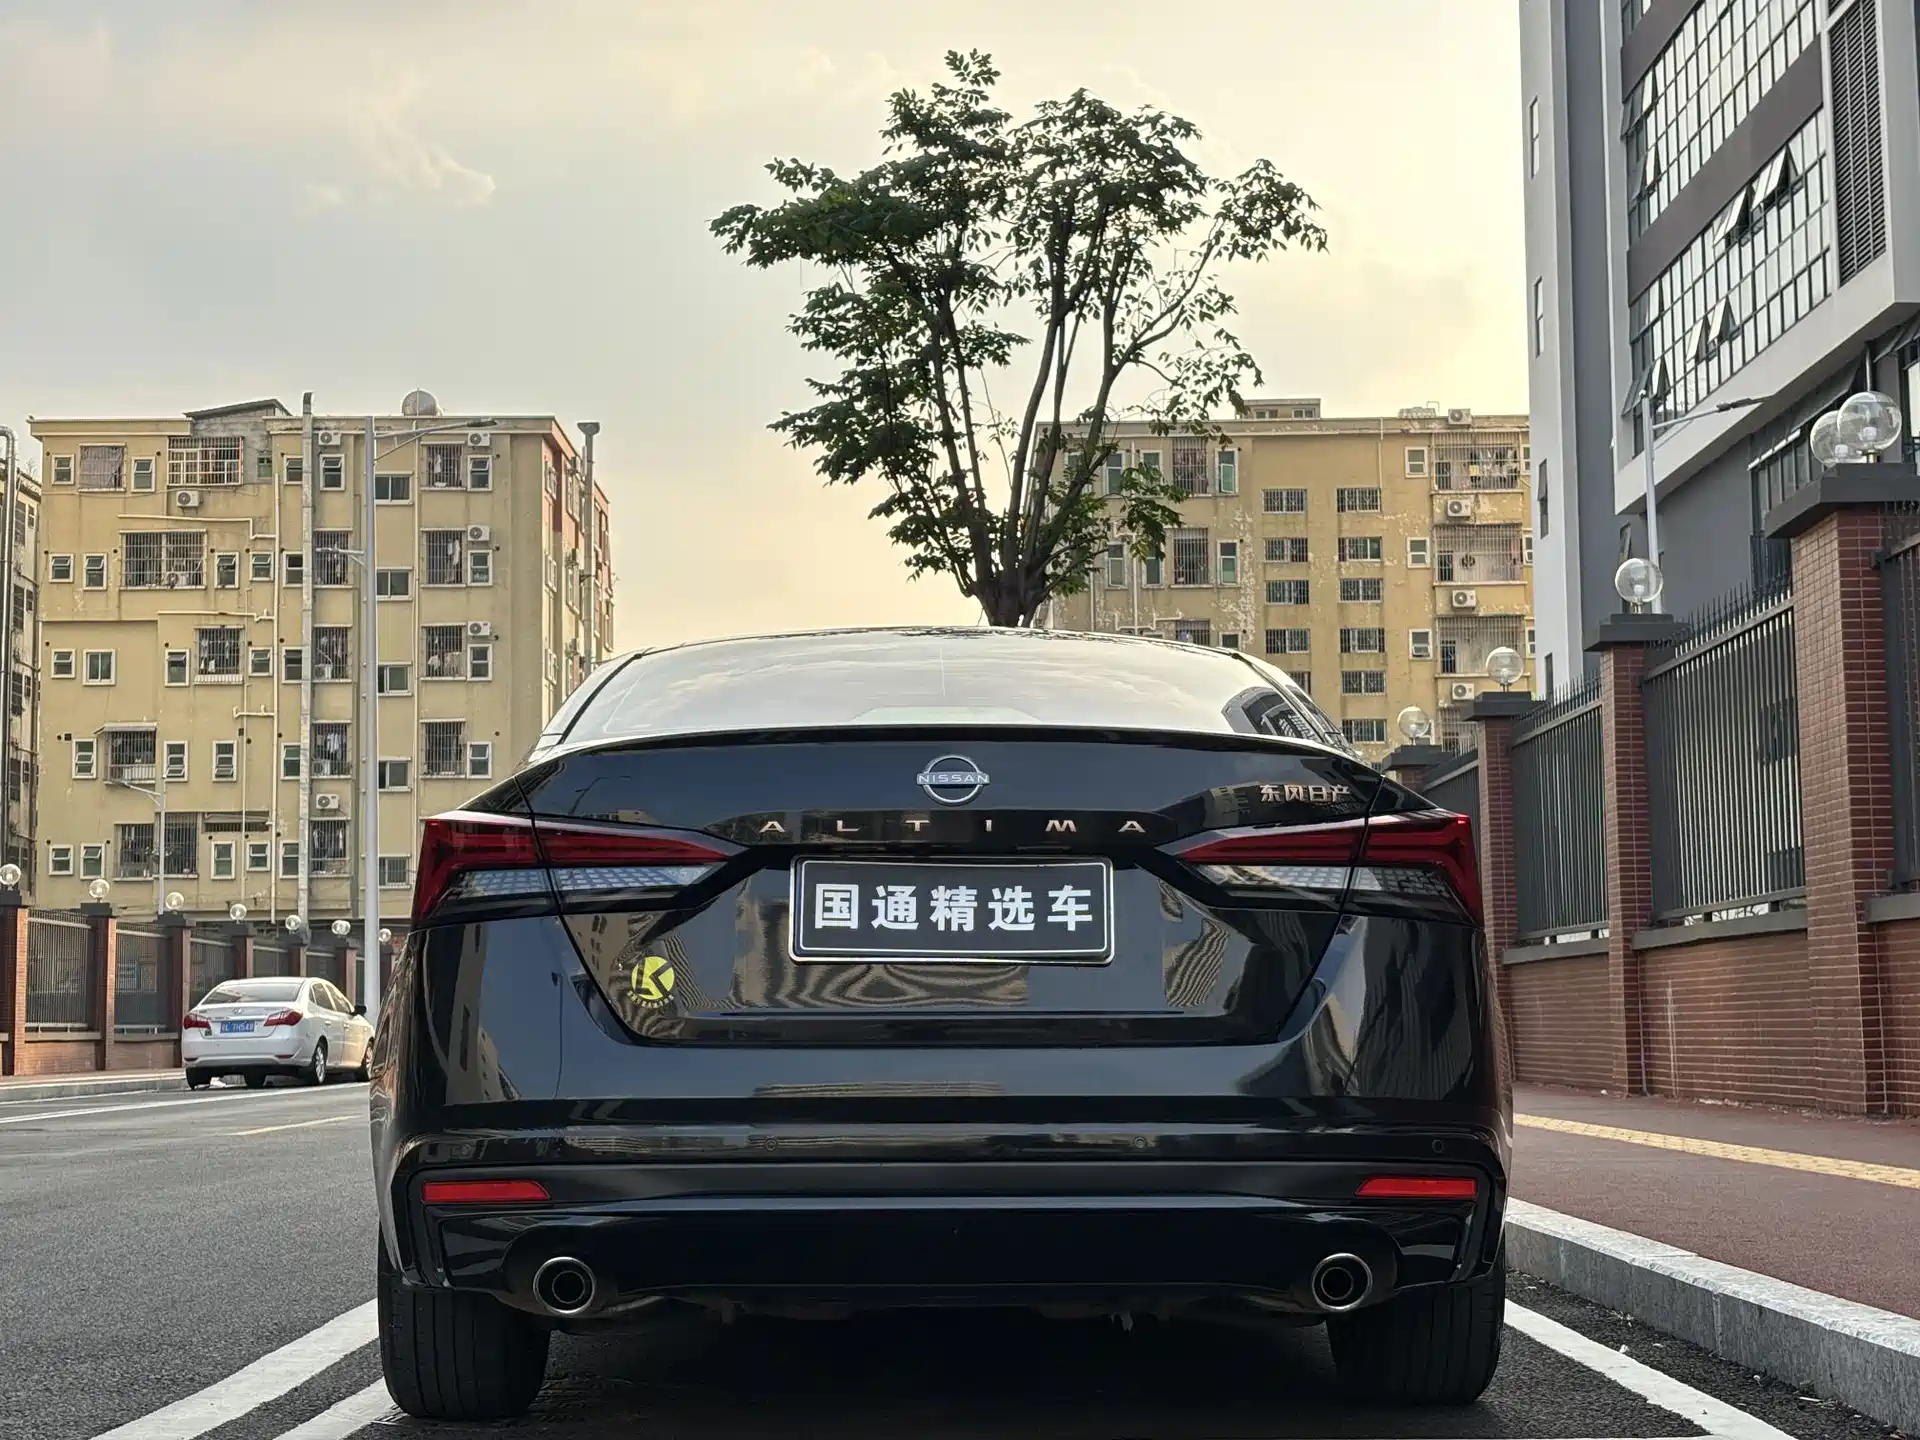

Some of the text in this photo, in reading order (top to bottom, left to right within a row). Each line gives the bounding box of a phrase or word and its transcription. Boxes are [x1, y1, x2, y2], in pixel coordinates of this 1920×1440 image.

[918, 774, 989, 783] NISSAN
[1259, 784, 1350, 802] 东风日产
[759, 819, 1147, 833] ALTIMA
[814, 883, 1093, 932] 国通精选车
